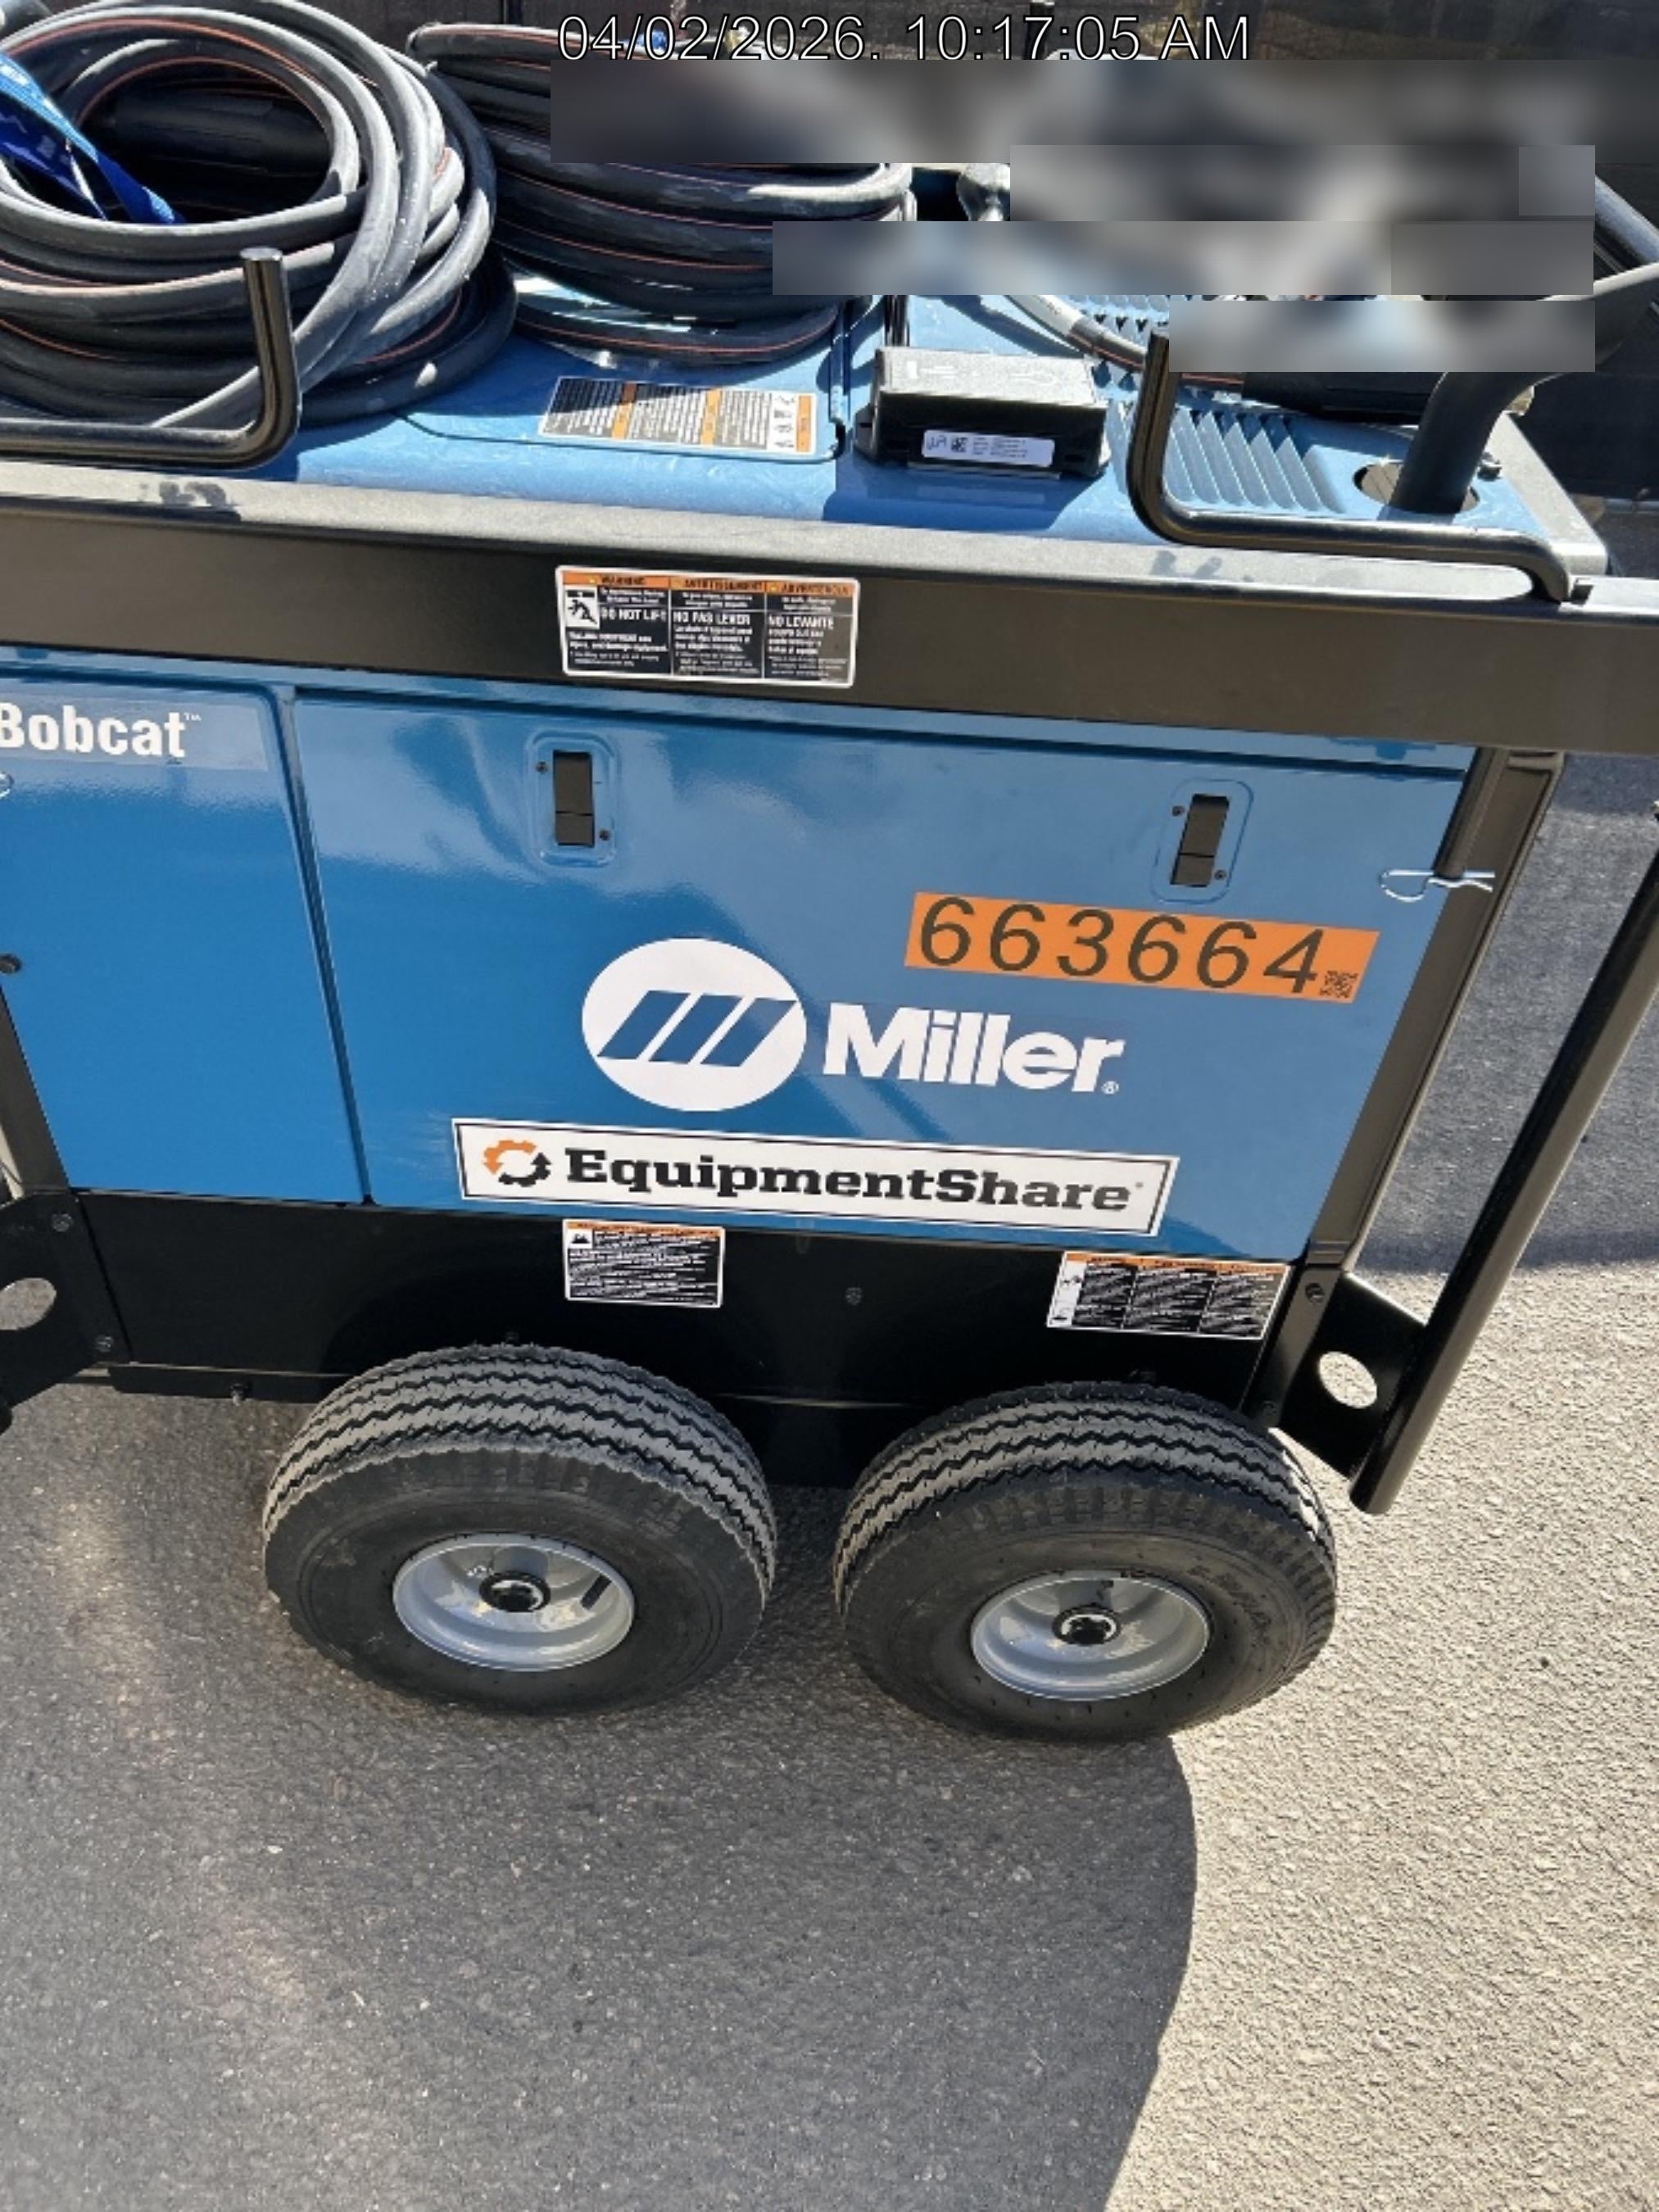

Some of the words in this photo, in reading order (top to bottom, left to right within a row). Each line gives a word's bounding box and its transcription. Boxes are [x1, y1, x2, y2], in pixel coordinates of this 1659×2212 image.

[619, 609, 642, 621] NOT
[920, 896, 1325, 994] 663664
[565, 1147, 1131, 1212] EquipmentShare
